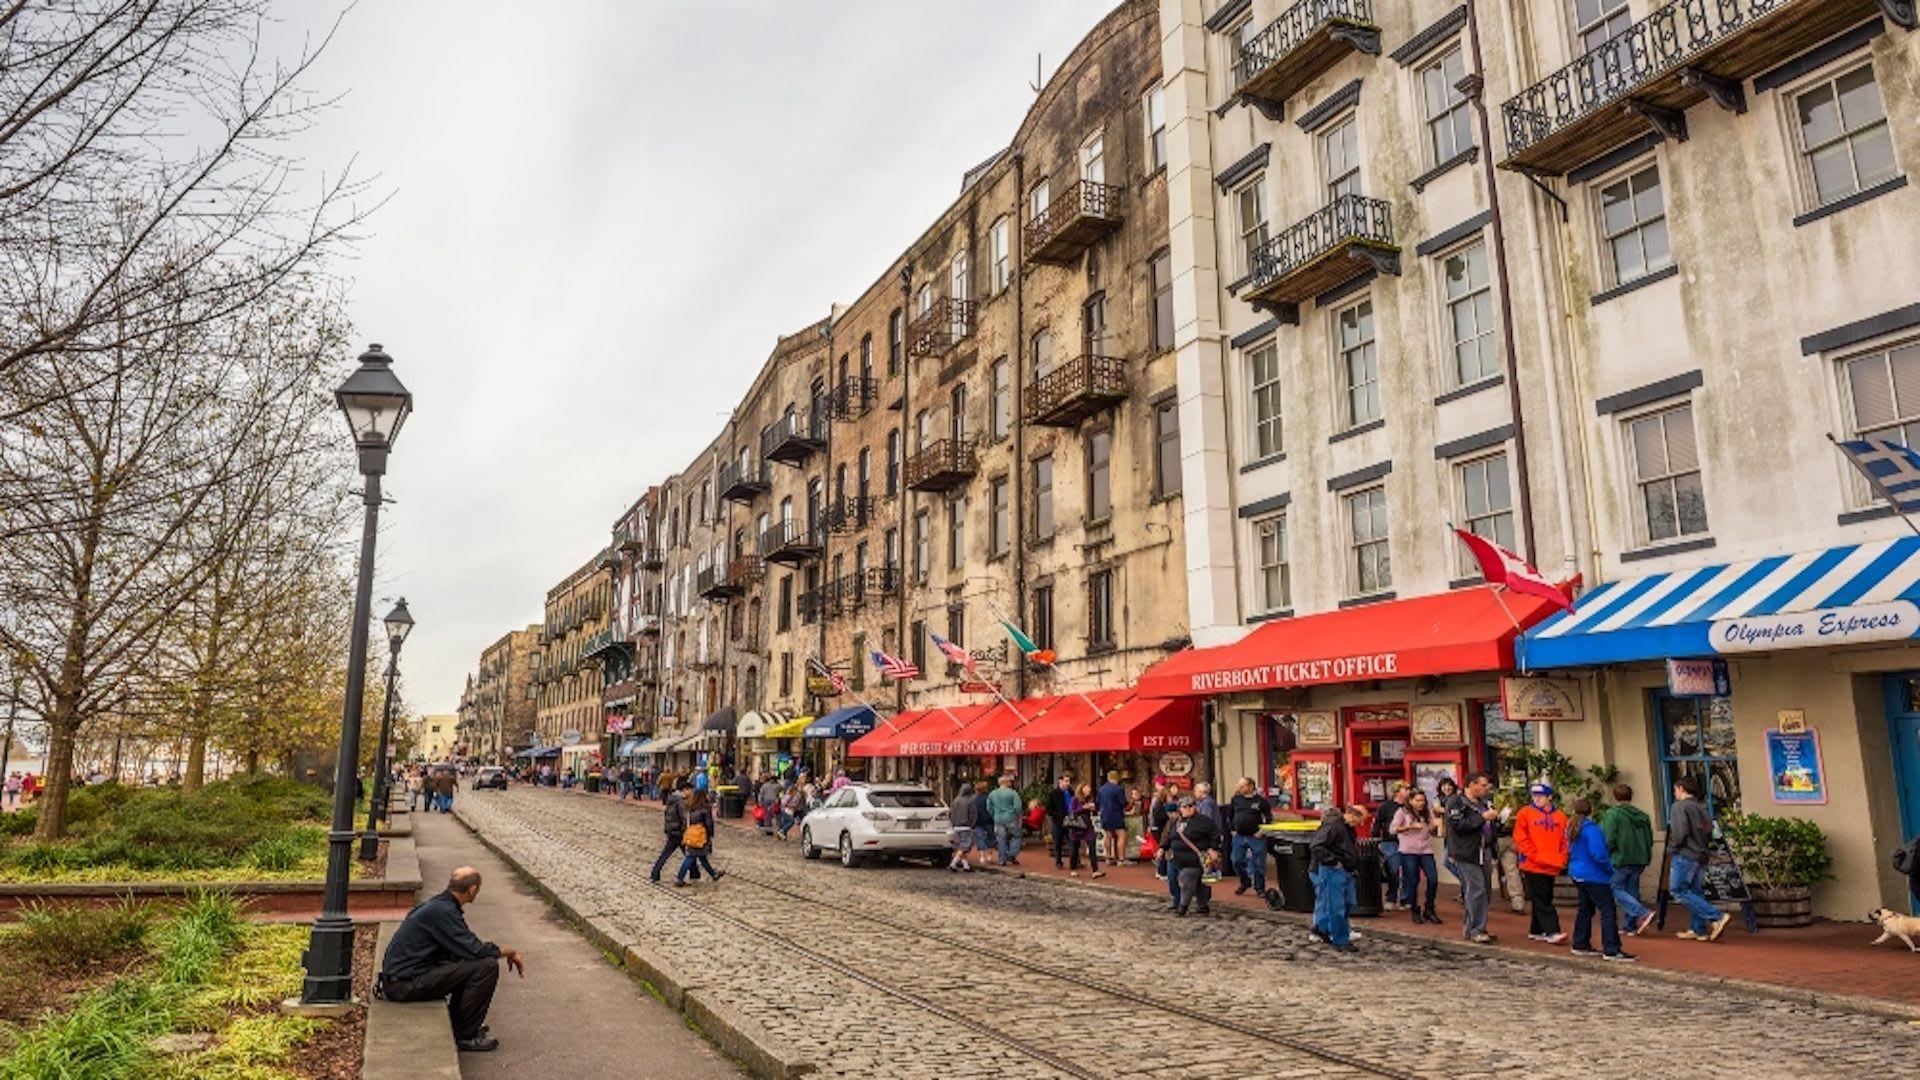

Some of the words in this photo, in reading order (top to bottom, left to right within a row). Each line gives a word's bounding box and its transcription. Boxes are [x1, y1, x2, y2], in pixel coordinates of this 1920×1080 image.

[1725, 624, 1805, 645] Olympia
[1818, 611, 1902, 635] Express
[1191, 666, 1270, 691] RIVERBOAT
[1272, 659, 1331, 683] TICKET
[1333, 653, 1397, 677] OFFICE
[1143, 735, 1164, 747] EST
